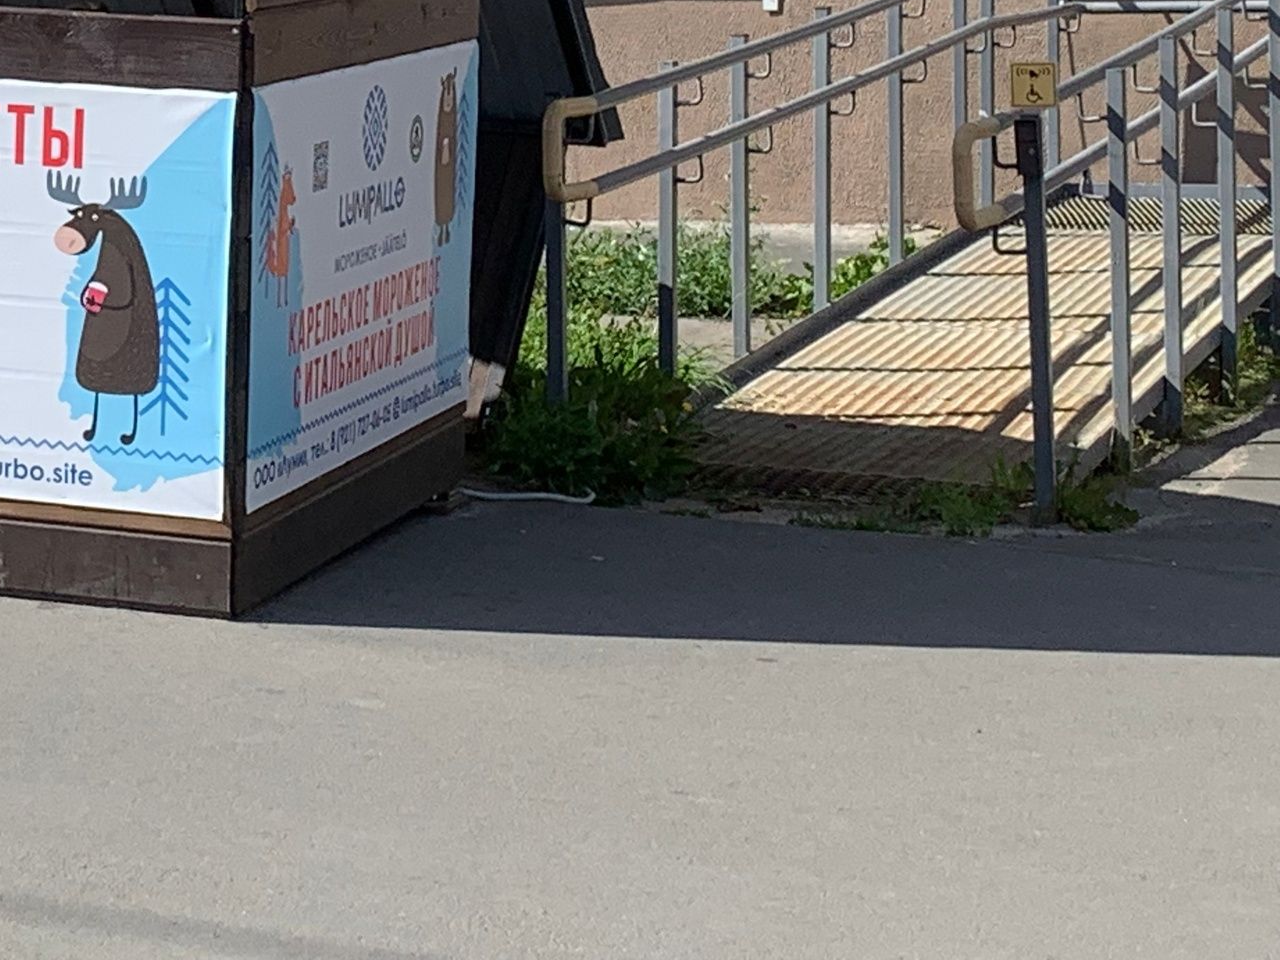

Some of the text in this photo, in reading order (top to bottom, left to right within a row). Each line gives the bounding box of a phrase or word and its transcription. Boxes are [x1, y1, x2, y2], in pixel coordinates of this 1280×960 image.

[339, 176, 406, 227] LUMIPALLO
[288, 256, 442, 356] КАРЕЛЬСКОЕ МОРОЖЕНОЕ
[293, 301, 435, 409] С ИТАЛЬЯНСКОЙ ДУШОЙ
